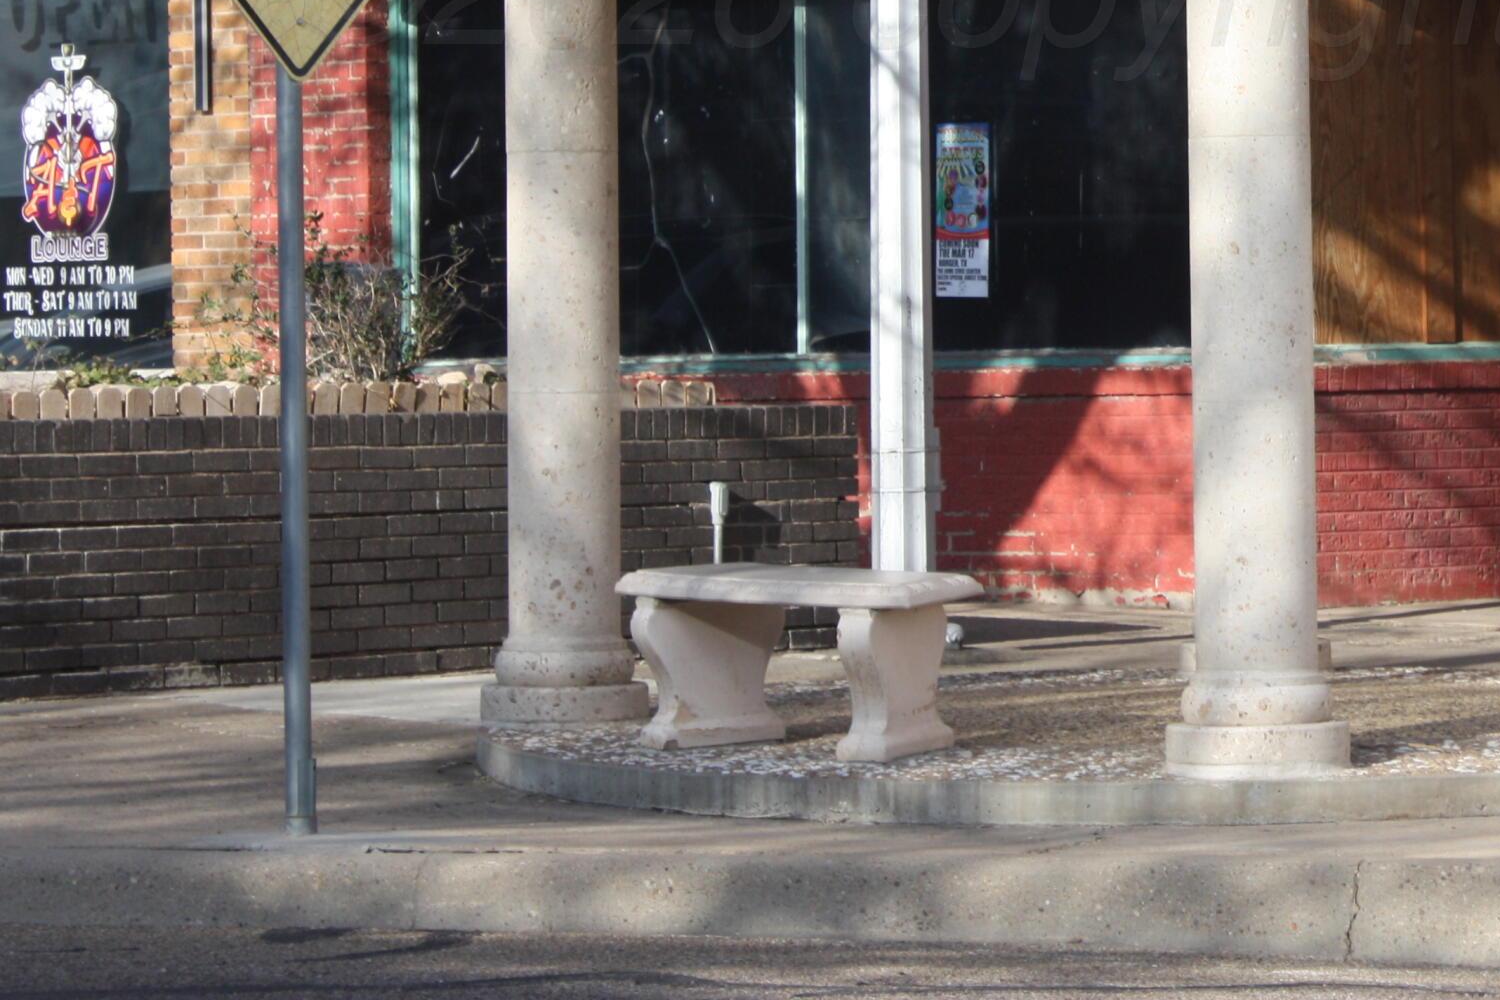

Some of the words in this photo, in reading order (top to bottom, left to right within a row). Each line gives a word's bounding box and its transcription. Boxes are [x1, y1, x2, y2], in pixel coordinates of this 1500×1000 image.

[31, 233, 109, 263] LOUNGE
[6, 266, 26, 286] MON
[60, 266, 67, 285] 9
[70, 266, 85, 285] AM
[88, 265, 103, 285] TO
[105, 266, 116, 285] 10
[119, 265, 134, 285] PM
[42, 290, 65, 311] SAT
[68, 291, 75, 310] 9
[78, 291, 93, 310] AM
[96, 290, 111, 310] TO
[113, 291, 119, 310] 1
[121, 291, 137, 310] AM
[14, 317, 54, 338] SUNDAY
[69, 318, 85, 337] AM
[88, 317, 102, 337] TO
[104, 318, 111, 337] 9
[114, 318, 130, 337] PM
